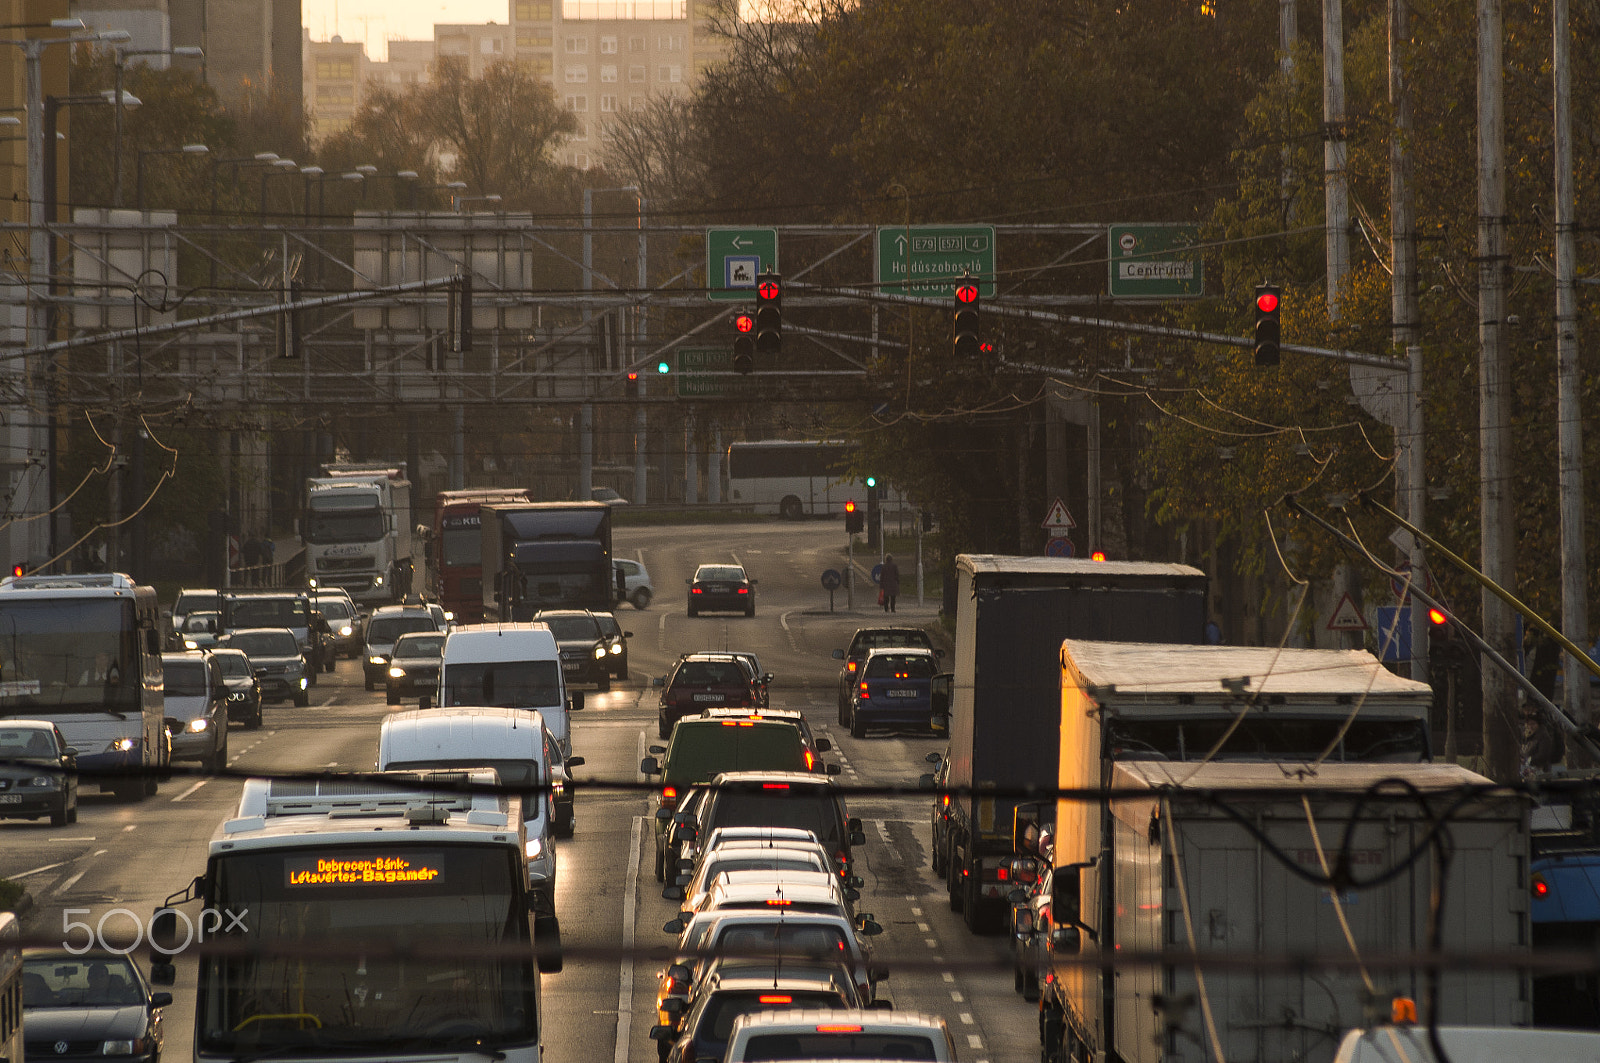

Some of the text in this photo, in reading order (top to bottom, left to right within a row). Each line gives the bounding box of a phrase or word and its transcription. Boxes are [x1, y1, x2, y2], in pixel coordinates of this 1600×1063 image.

[915, 238, 979, 250] E79 E573 4
[892, 258, 981, 273] Hadúszoboszló
[1127, 264, 1187, 276] Centrum
